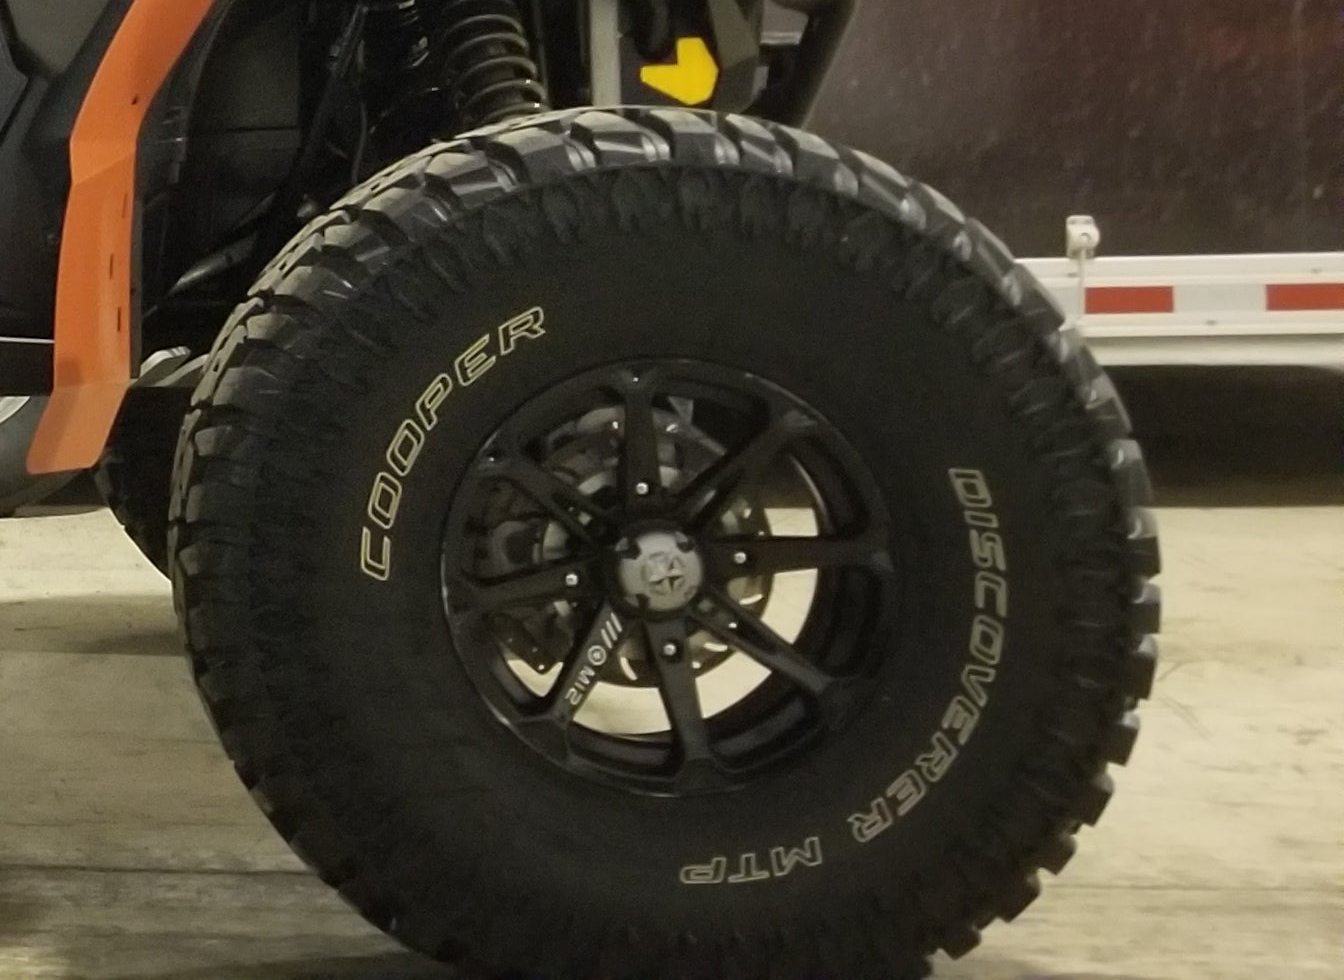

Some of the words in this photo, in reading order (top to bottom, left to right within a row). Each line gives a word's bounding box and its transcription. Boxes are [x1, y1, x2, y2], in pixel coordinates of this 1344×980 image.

[360, 305, 546, 582] COOPER
[847, 467, 1008, 843] DISCOVERER
[679, 836, 823, 885] MTP
